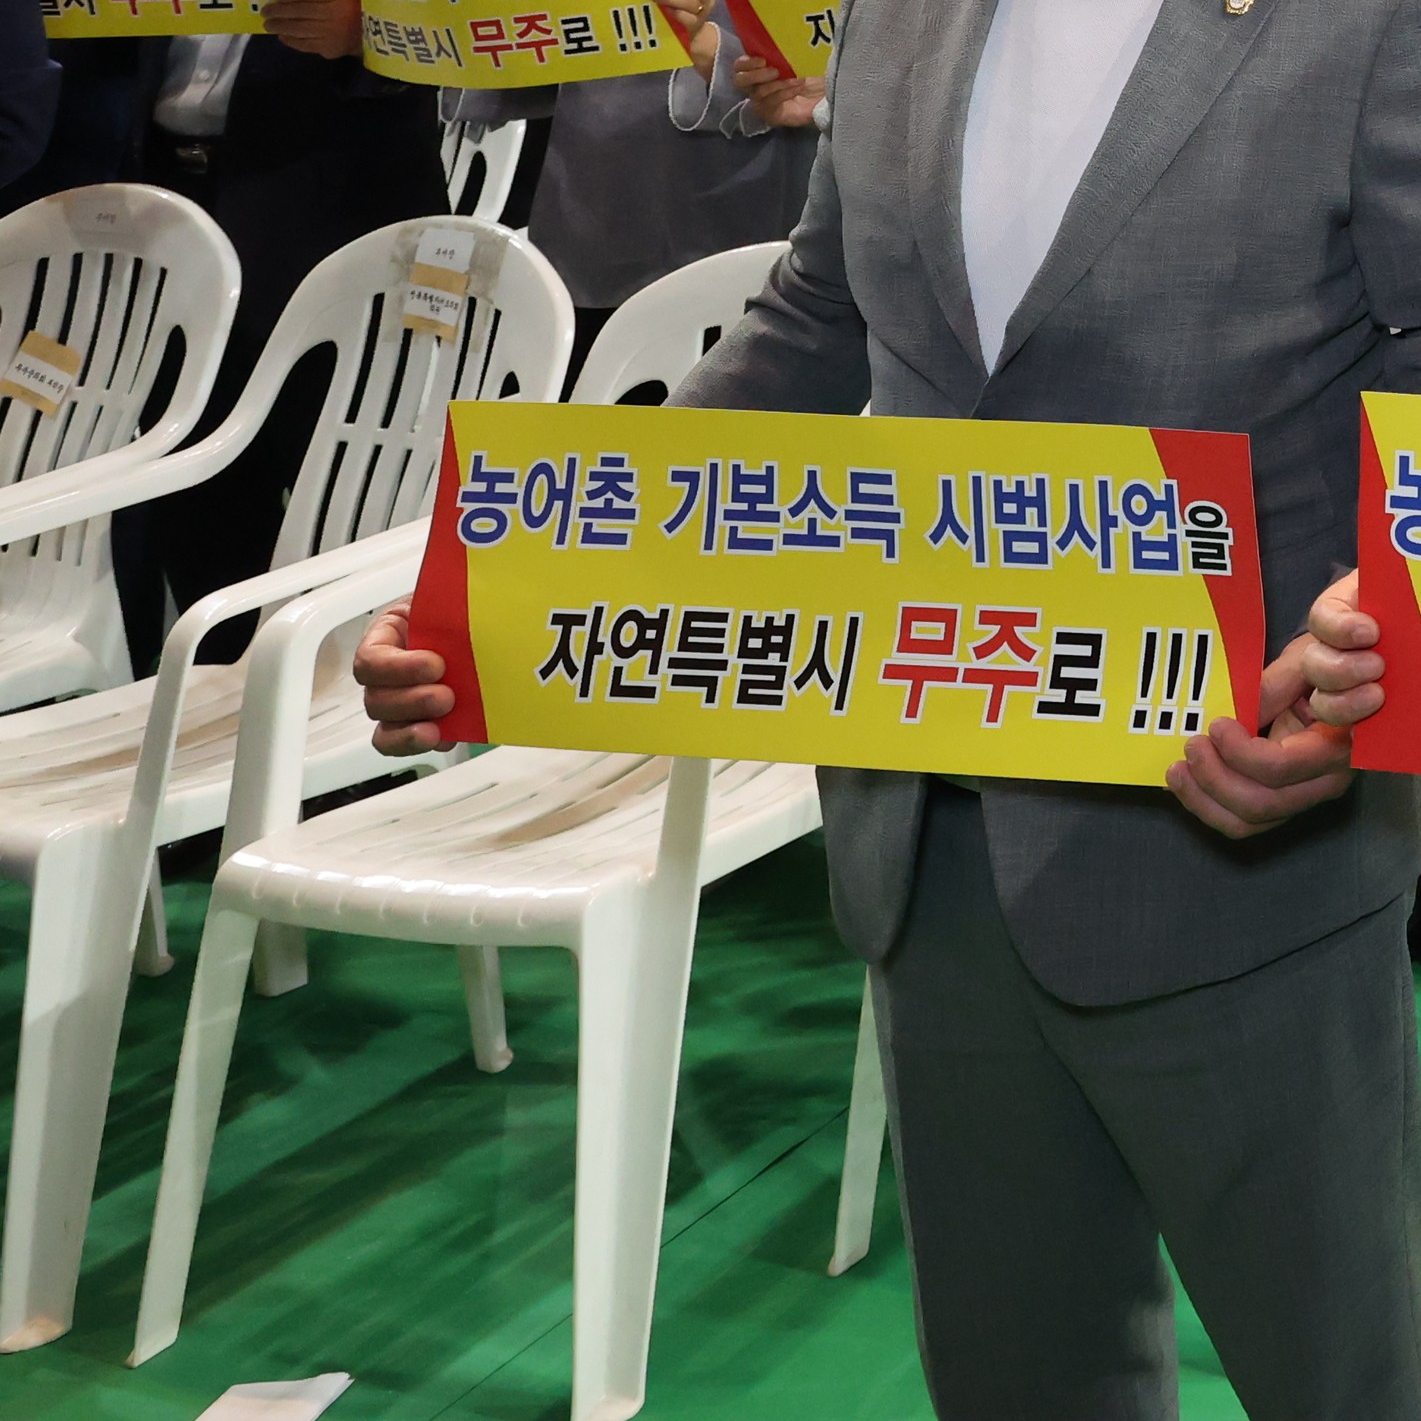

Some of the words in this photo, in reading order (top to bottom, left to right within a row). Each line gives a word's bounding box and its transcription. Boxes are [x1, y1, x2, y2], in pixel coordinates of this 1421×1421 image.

[469, 12, 600, 69] 무주로
[611, 5, 658, 53] !!!
[456, 451, 641, 549] 농어촌
[660, 457, 904, 562] 기본소득
[927, 472, 1235, 576] 시범사업을
[538, 602, 863, 715] 자연특별시
[880, 602, 1107, 728] 무주로
[1129, 628, 1213, 735] !!!
